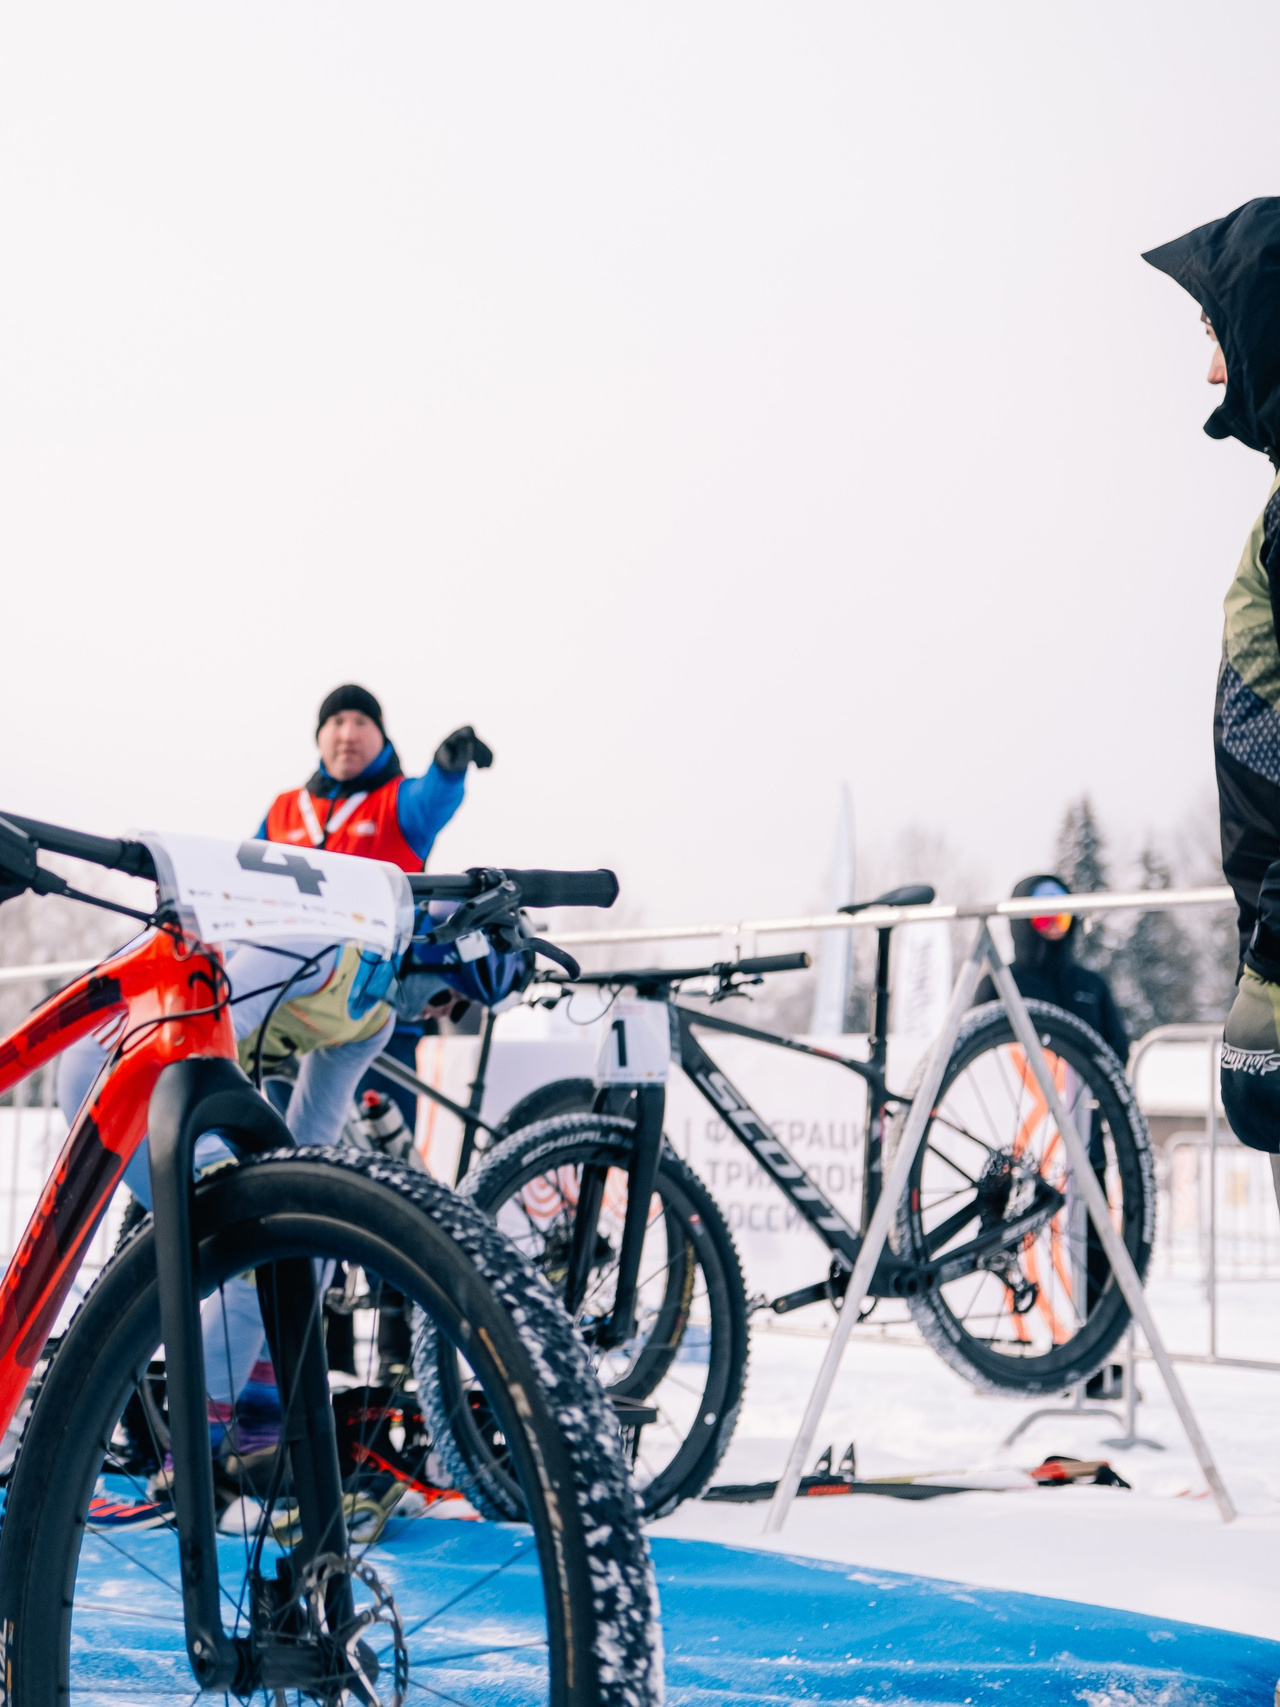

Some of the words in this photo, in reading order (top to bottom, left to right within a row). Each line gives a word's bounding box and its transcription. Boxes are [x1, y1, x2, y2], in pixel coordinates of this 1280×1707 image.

[236, 839, 327, 897] 4
[611, 1019, 628, 1068] 1
[695, 1070, 859, 1241] SCOTT
